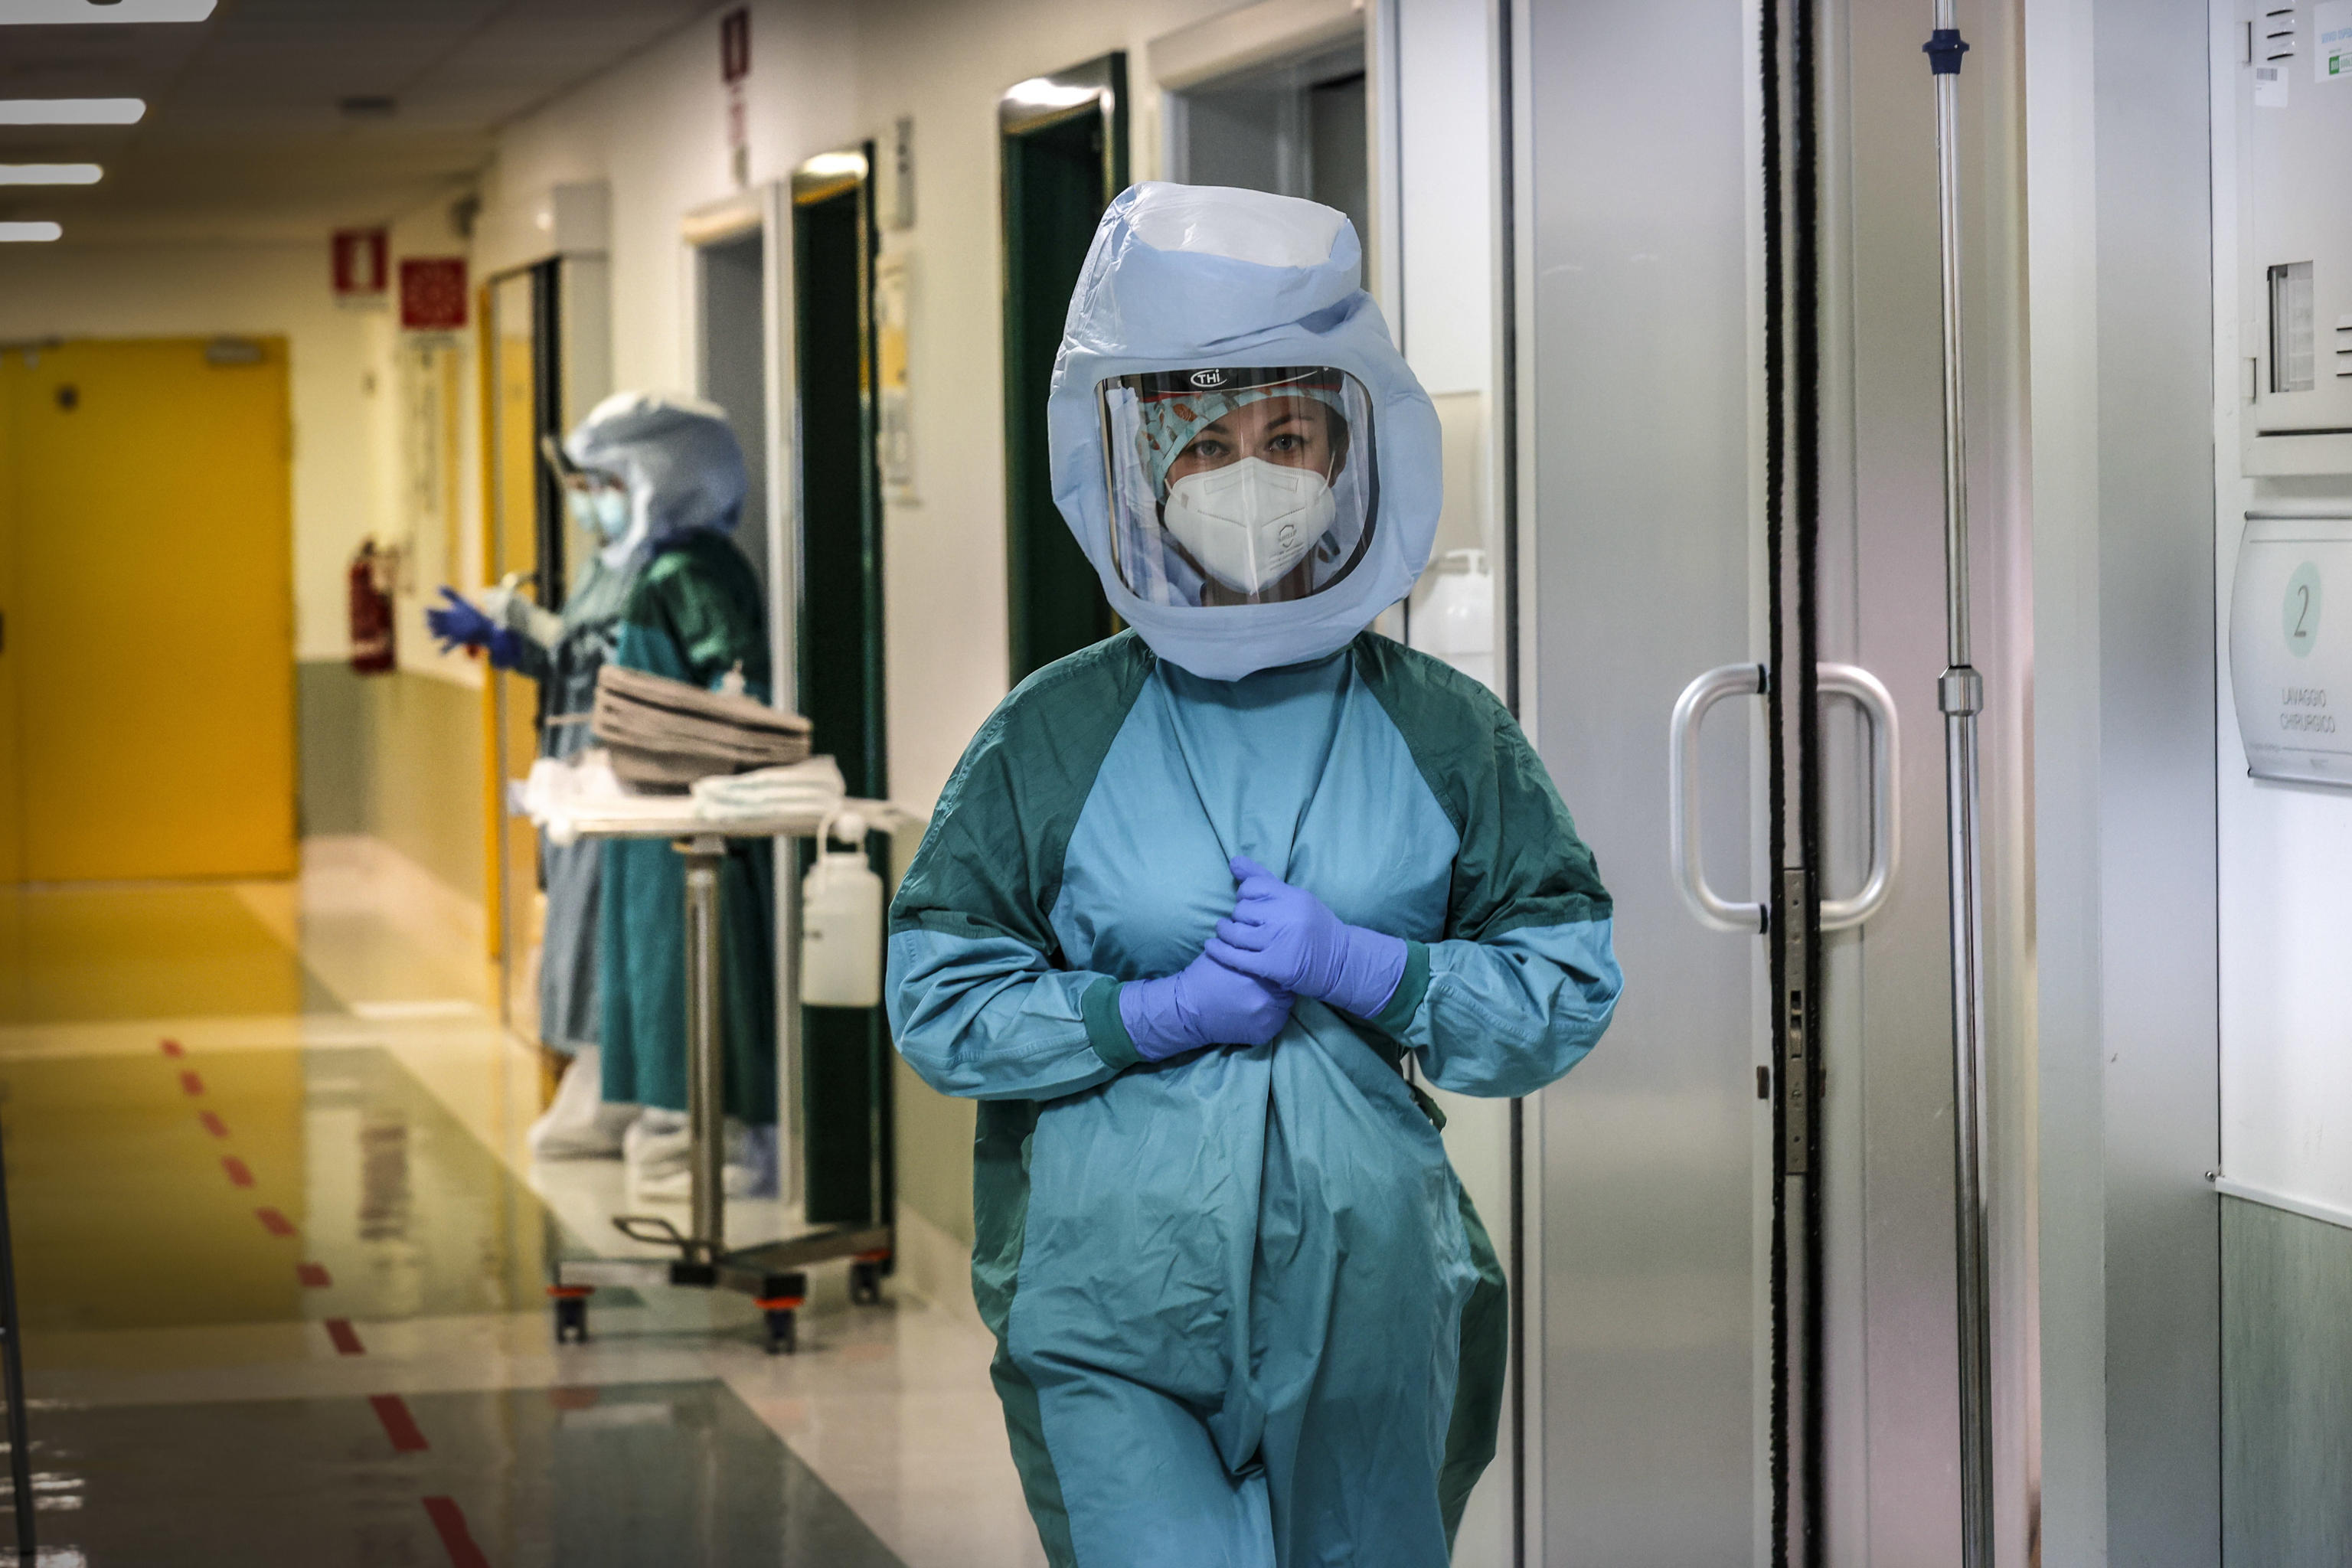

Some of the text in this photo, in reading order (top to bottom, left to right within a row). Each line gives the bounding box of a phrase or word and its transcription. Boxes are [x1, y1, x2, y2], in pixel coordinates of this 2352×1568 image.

[2294, 585, 2309, 636] 2
[2282, 688, 2326, 707] LAVAGGIO
[2280, 713, 2335, 733] CHIRURGICO
